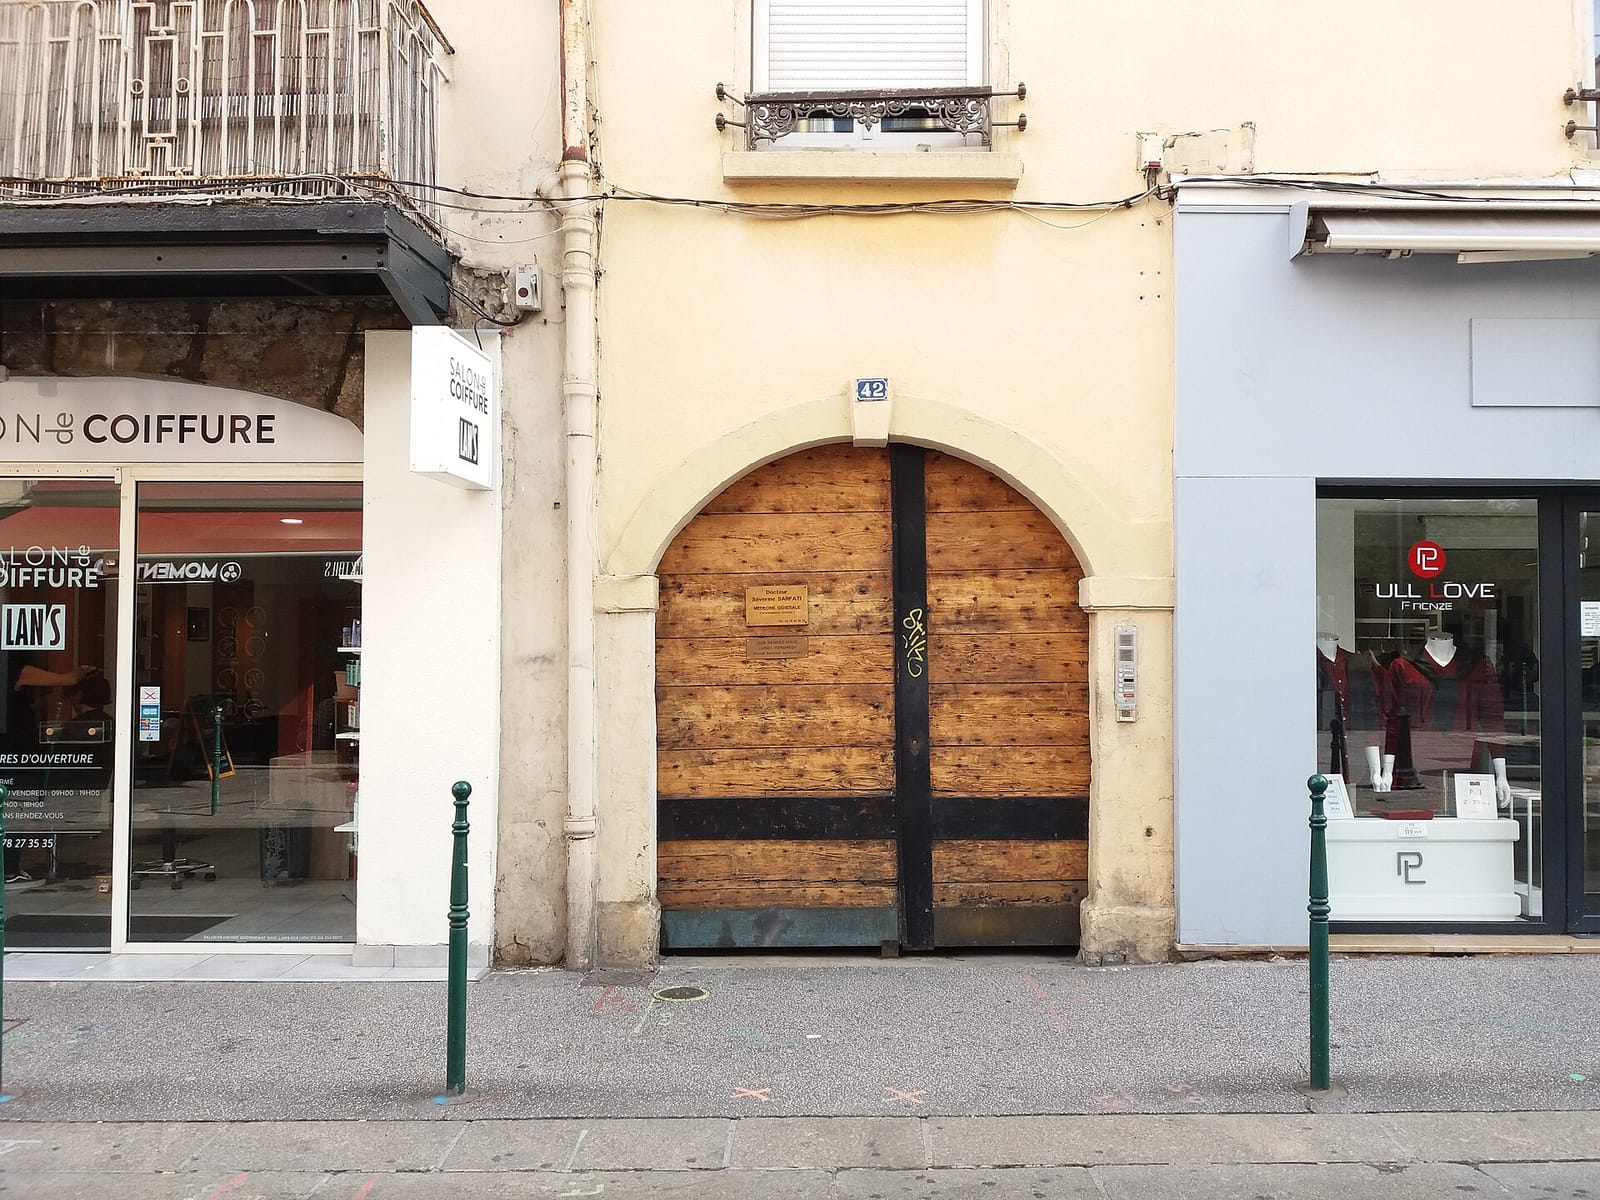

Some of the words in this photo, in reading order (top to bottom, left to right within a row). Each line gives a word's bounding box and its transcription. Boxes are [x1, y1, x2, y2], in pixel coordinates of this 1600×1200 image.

[450, 357, 480, 387] SALON
[450, 378, 488, 415] COIFFURE
[861, 382, 884, 397] 42
[0, 413, 40, 443] N
[83, 414, 276, 443] COIFFURE
[5, 606, 62, 646] LAN'S
[21, 754, 94, 763] D'OUVERTURE
[15, 838, 26, 848] 27
[28, 838, 39, 848] 35
[41, 838, 53, 848] 35
